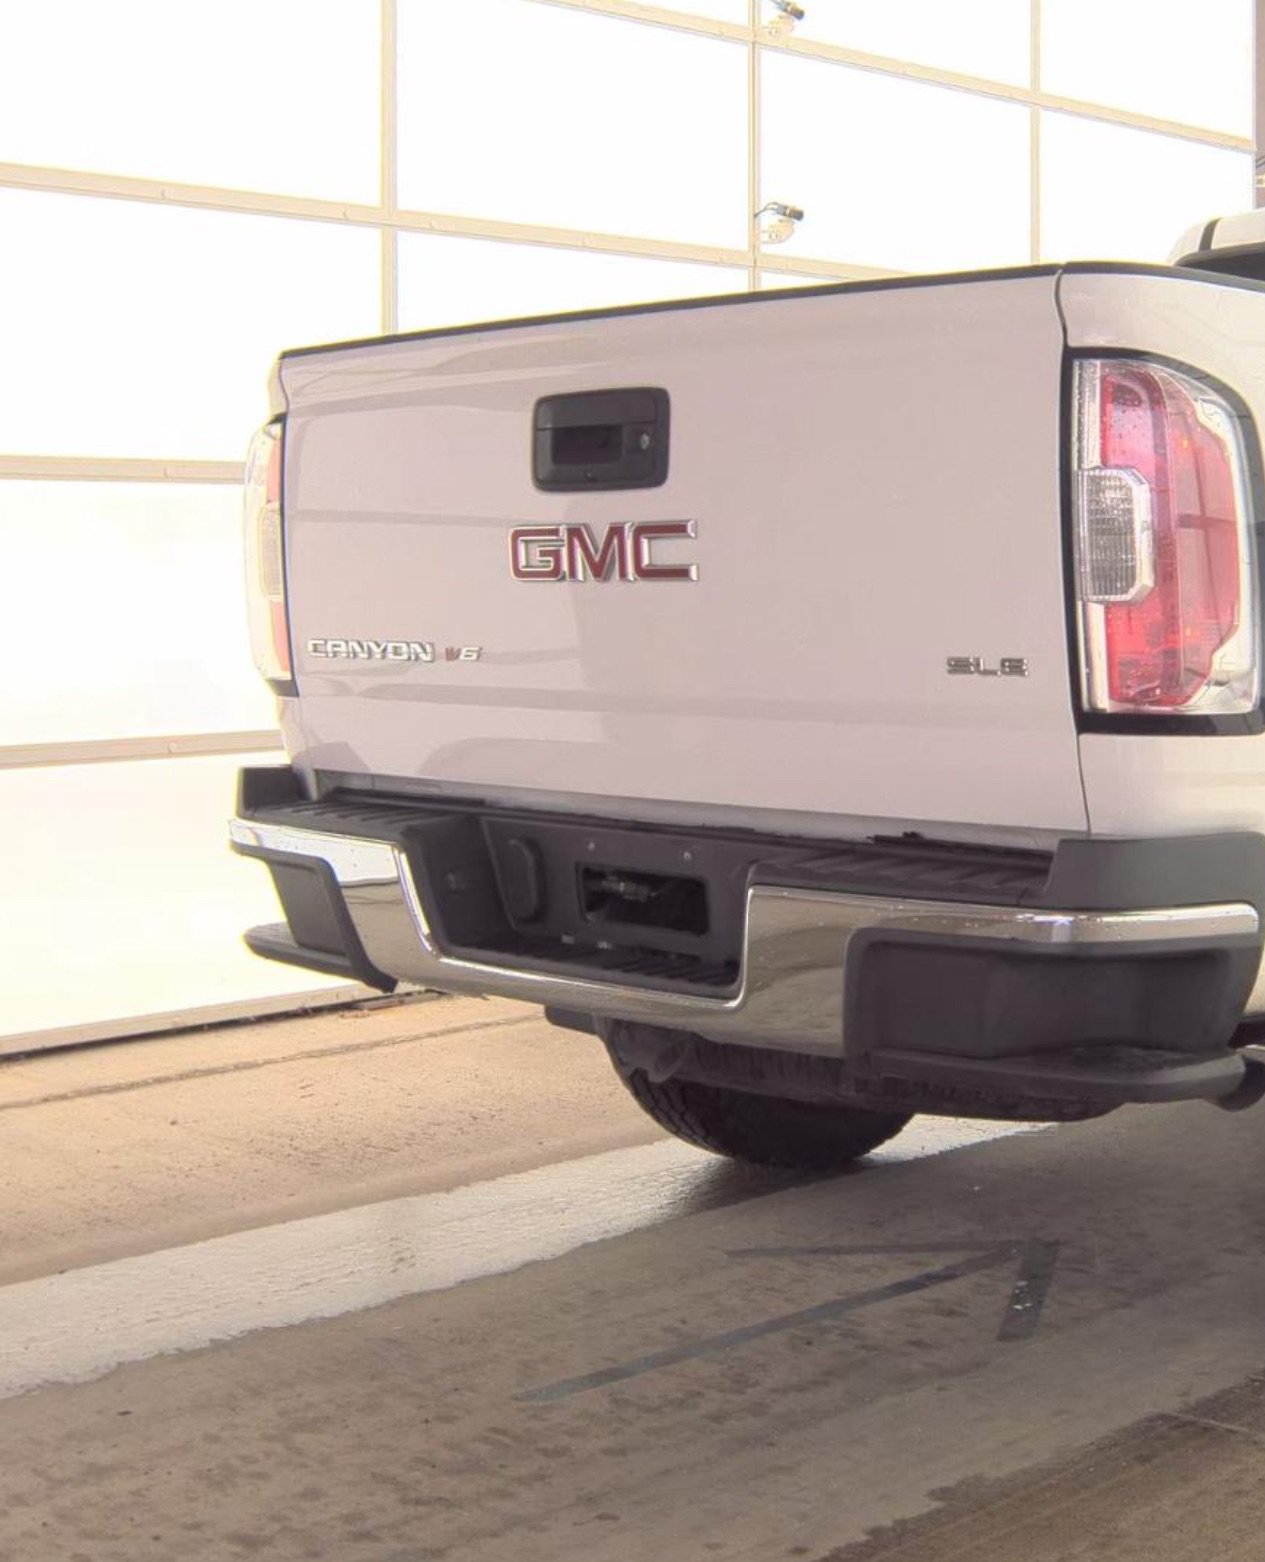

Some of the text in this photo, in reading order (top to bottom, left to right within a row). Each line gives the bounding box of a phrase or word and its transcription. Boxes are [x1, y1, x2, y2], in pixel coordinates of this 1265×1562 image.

[509, 520, 698, 583] GMC
[307, 639, 481, 662] CANYON V6
[947, 657, 1028, 677] SLE
